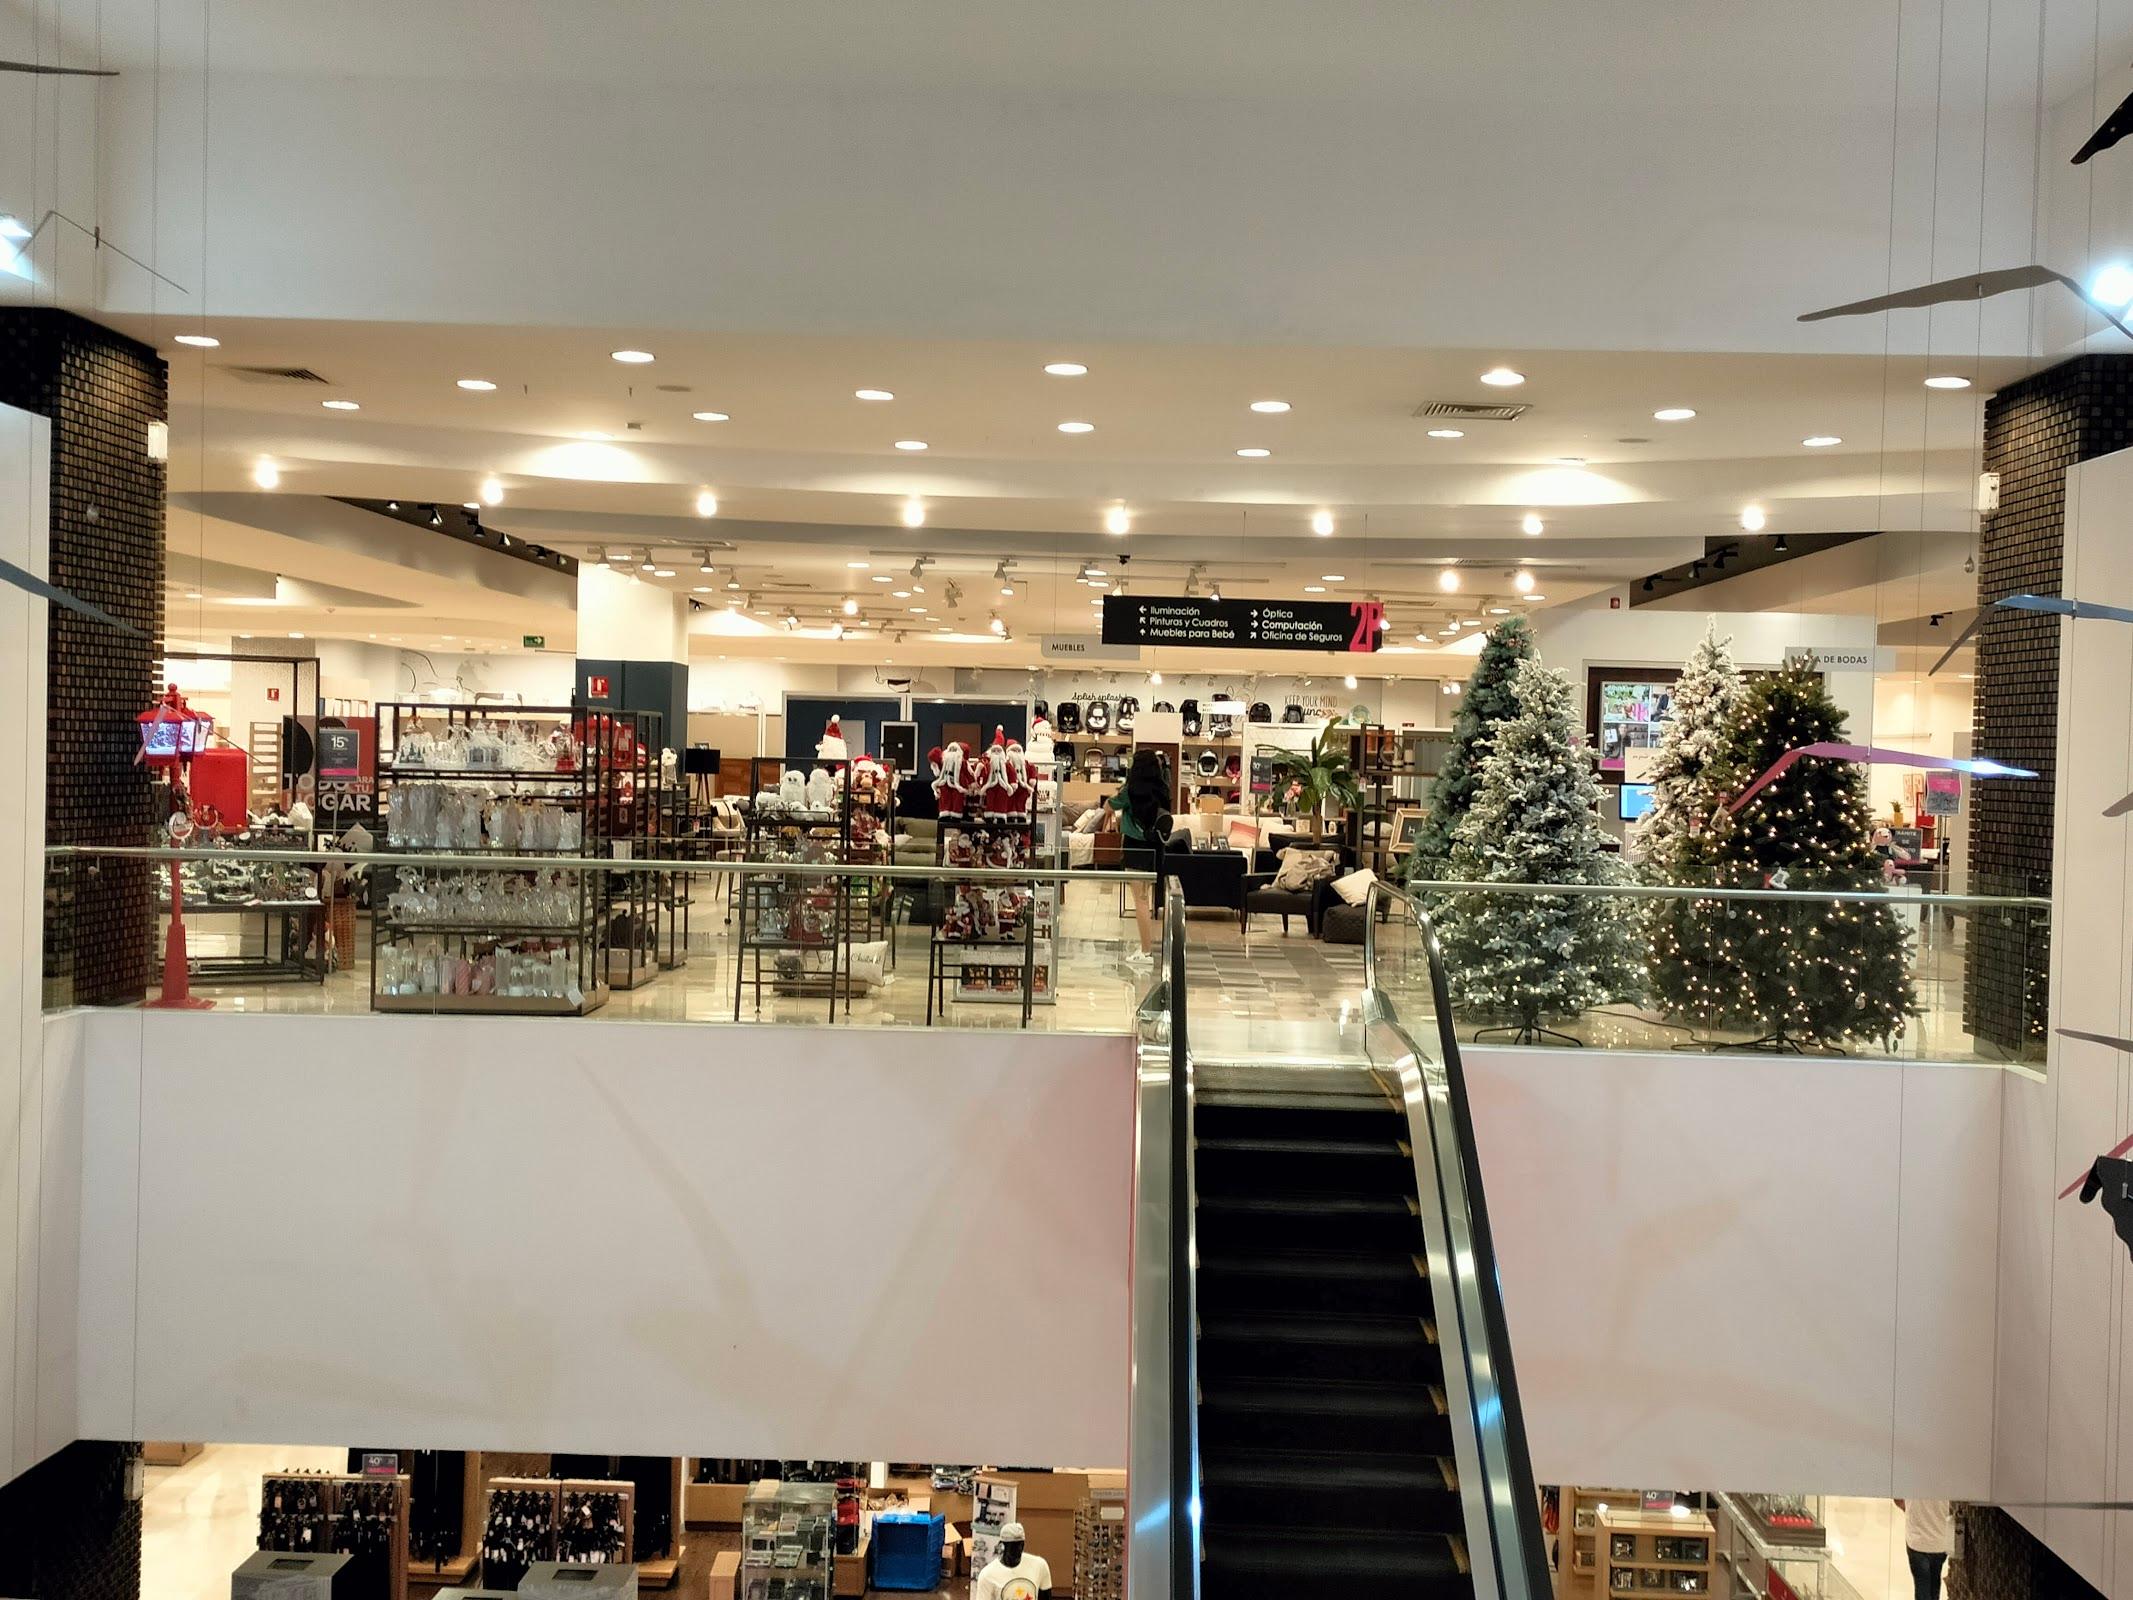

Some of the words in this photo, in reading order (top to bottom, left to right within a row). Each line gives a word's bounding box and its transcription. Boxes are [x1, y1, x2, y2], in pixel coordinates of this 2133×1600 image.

[1150, 606, 1200, 616] Iluminación
[1262, 607, 1294, 620] Óptica
[1149, 617, 1183, 626] Pinturas
[1191, 618, 1229, 628] Cuadros
[1261, 620, 1323, 632] Computación
[1349, 602, 1384, 652] 2P
[1149, 628, 1187, 638] Muebles
[1188, 631, 1210, 640] para
[1211, 630, 1235, 639] Bebé
[1261, 631, 1293, 641] Oficina
[1294, 632, 1308, 641] de
[1308, 632, 1343, 643] Seguros
[1051, 643, 1085, 652] MUEBLES
[1823, 655, 1835, 664] DE
[1837, 656, 1868, 664] BODAS
[1301, 695, 1318, 707] YOUR
[355, 775, 374, 784] ARA
[355, 785, 370, 793] TU
